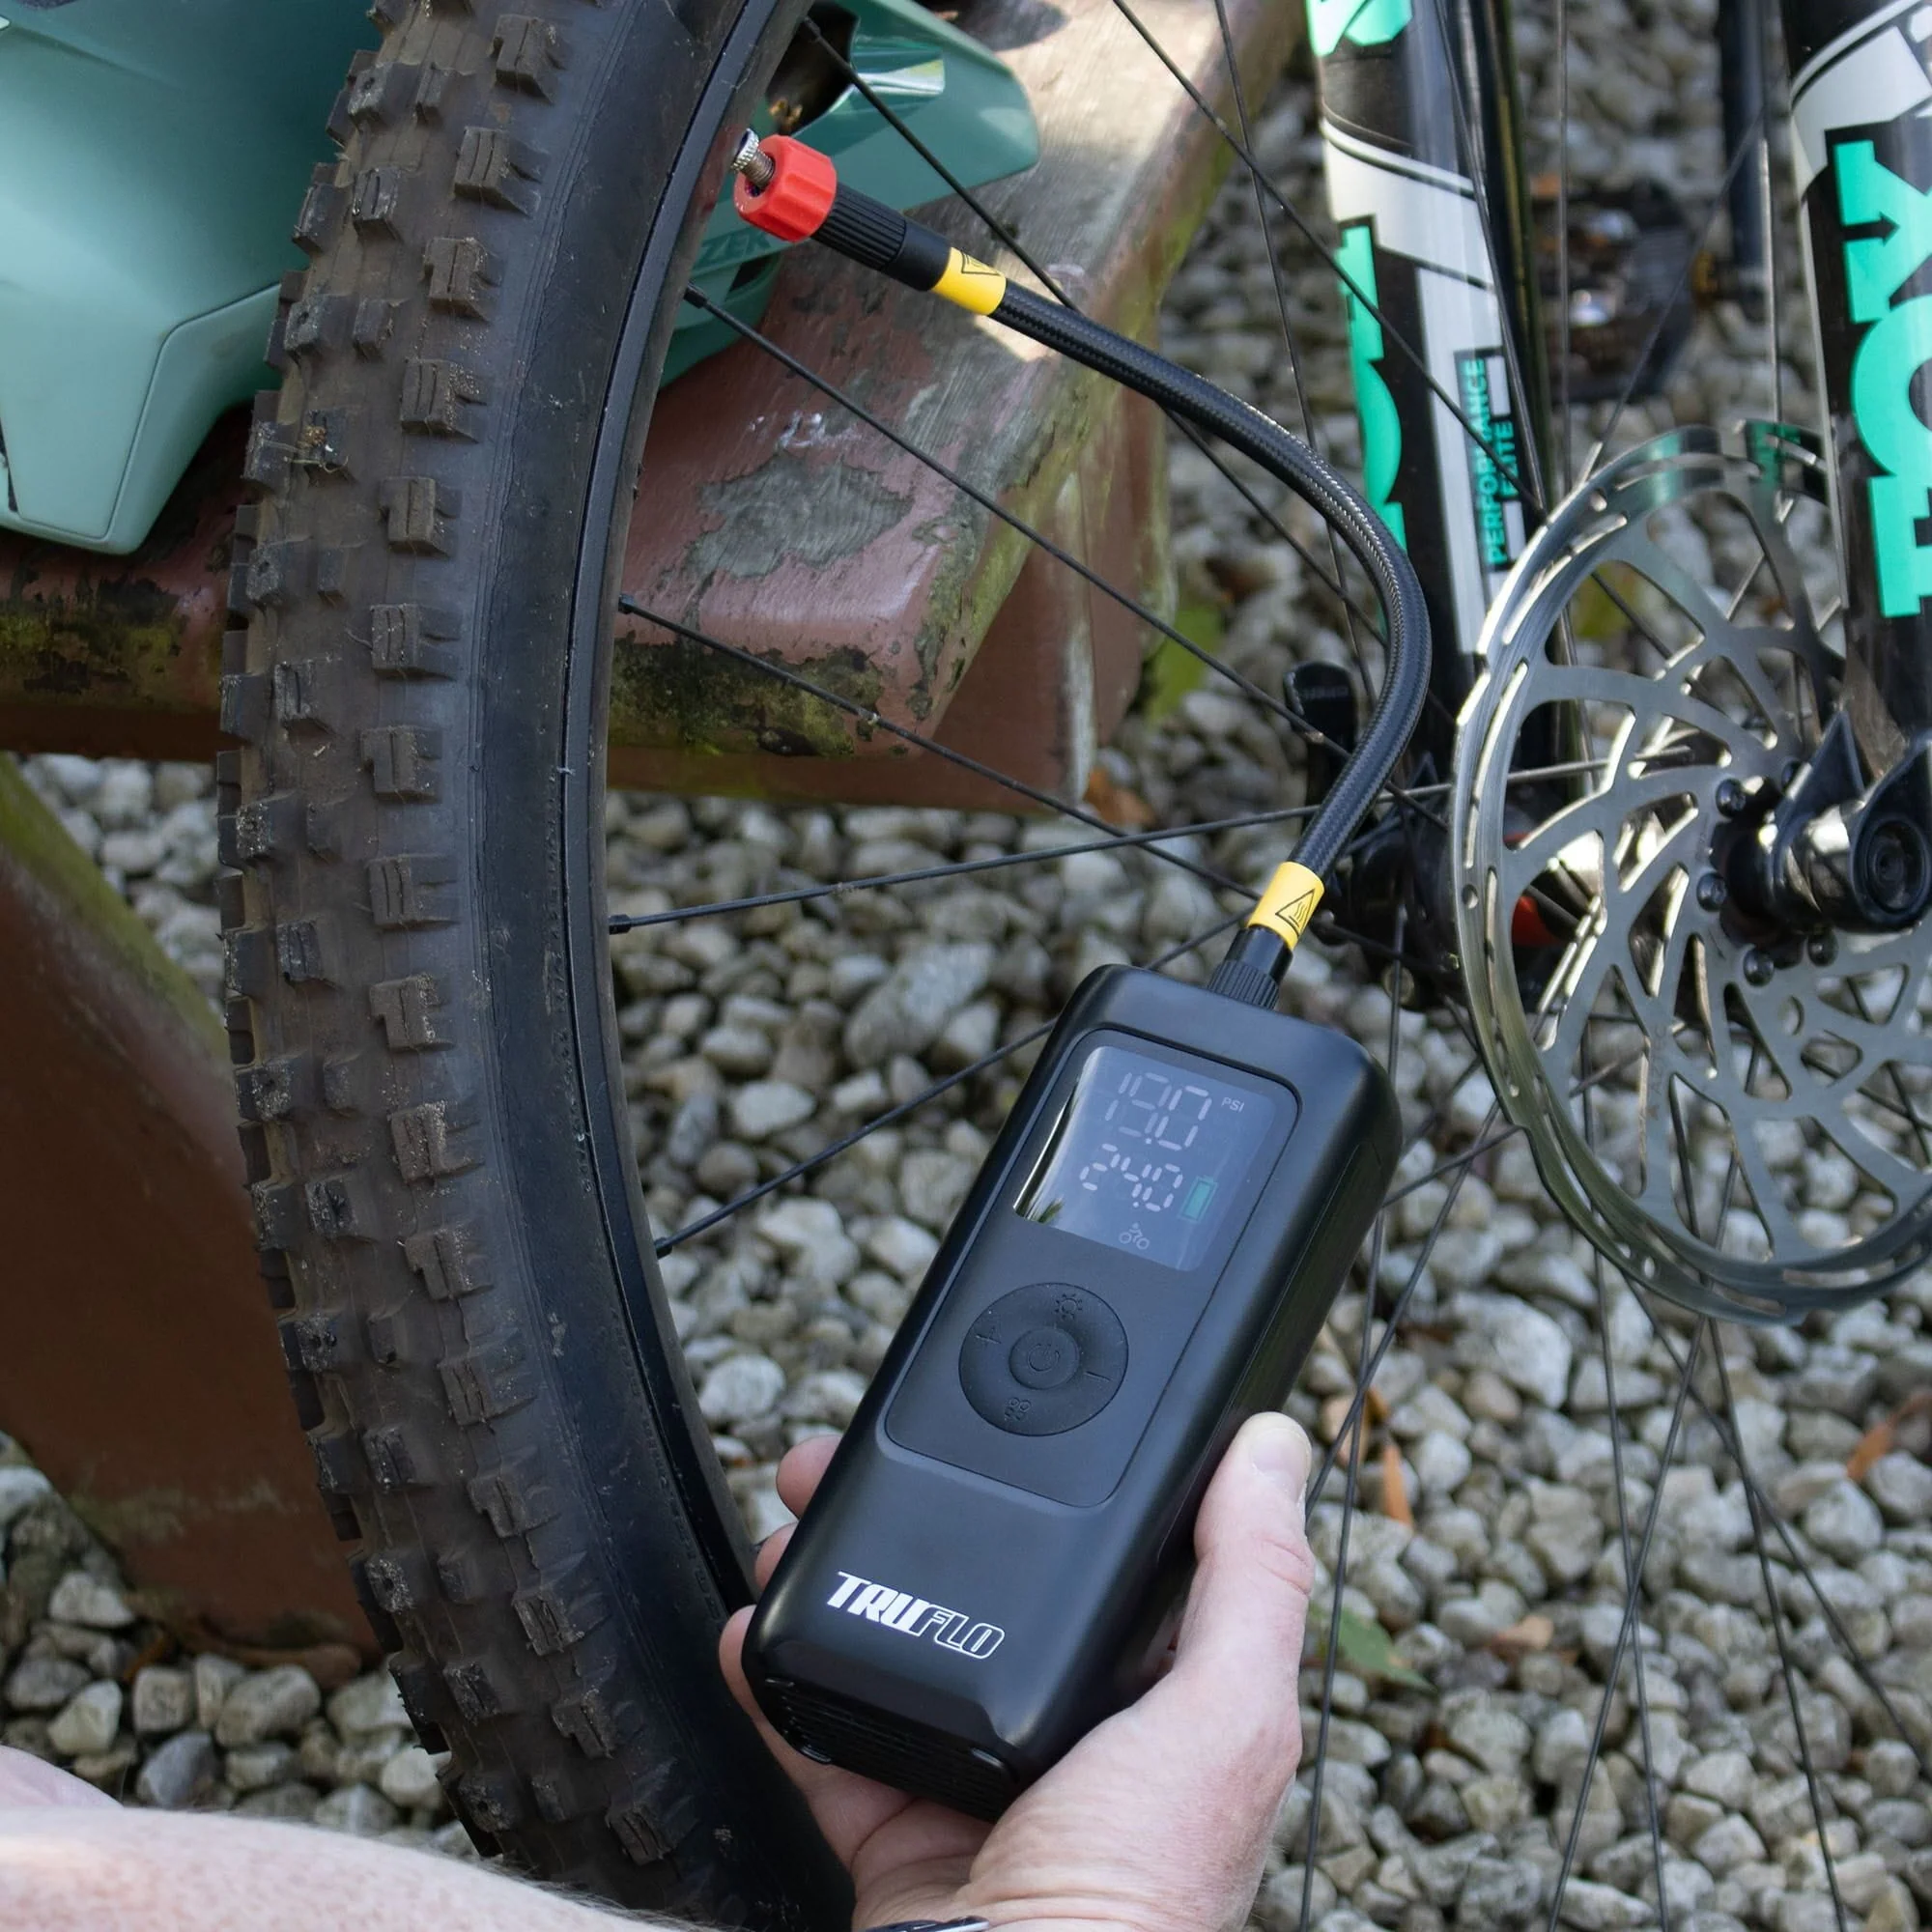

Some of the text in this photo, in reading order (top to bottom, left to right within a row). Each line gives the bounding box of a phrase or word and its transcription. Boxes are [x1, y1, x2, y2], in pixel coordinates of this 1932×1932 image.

[1220, 1095, 1245, 1113] PSI
[1079, 1143, 1184, 1213] 24.0
[826, 1571, 1006, 1660] TRUFLO
